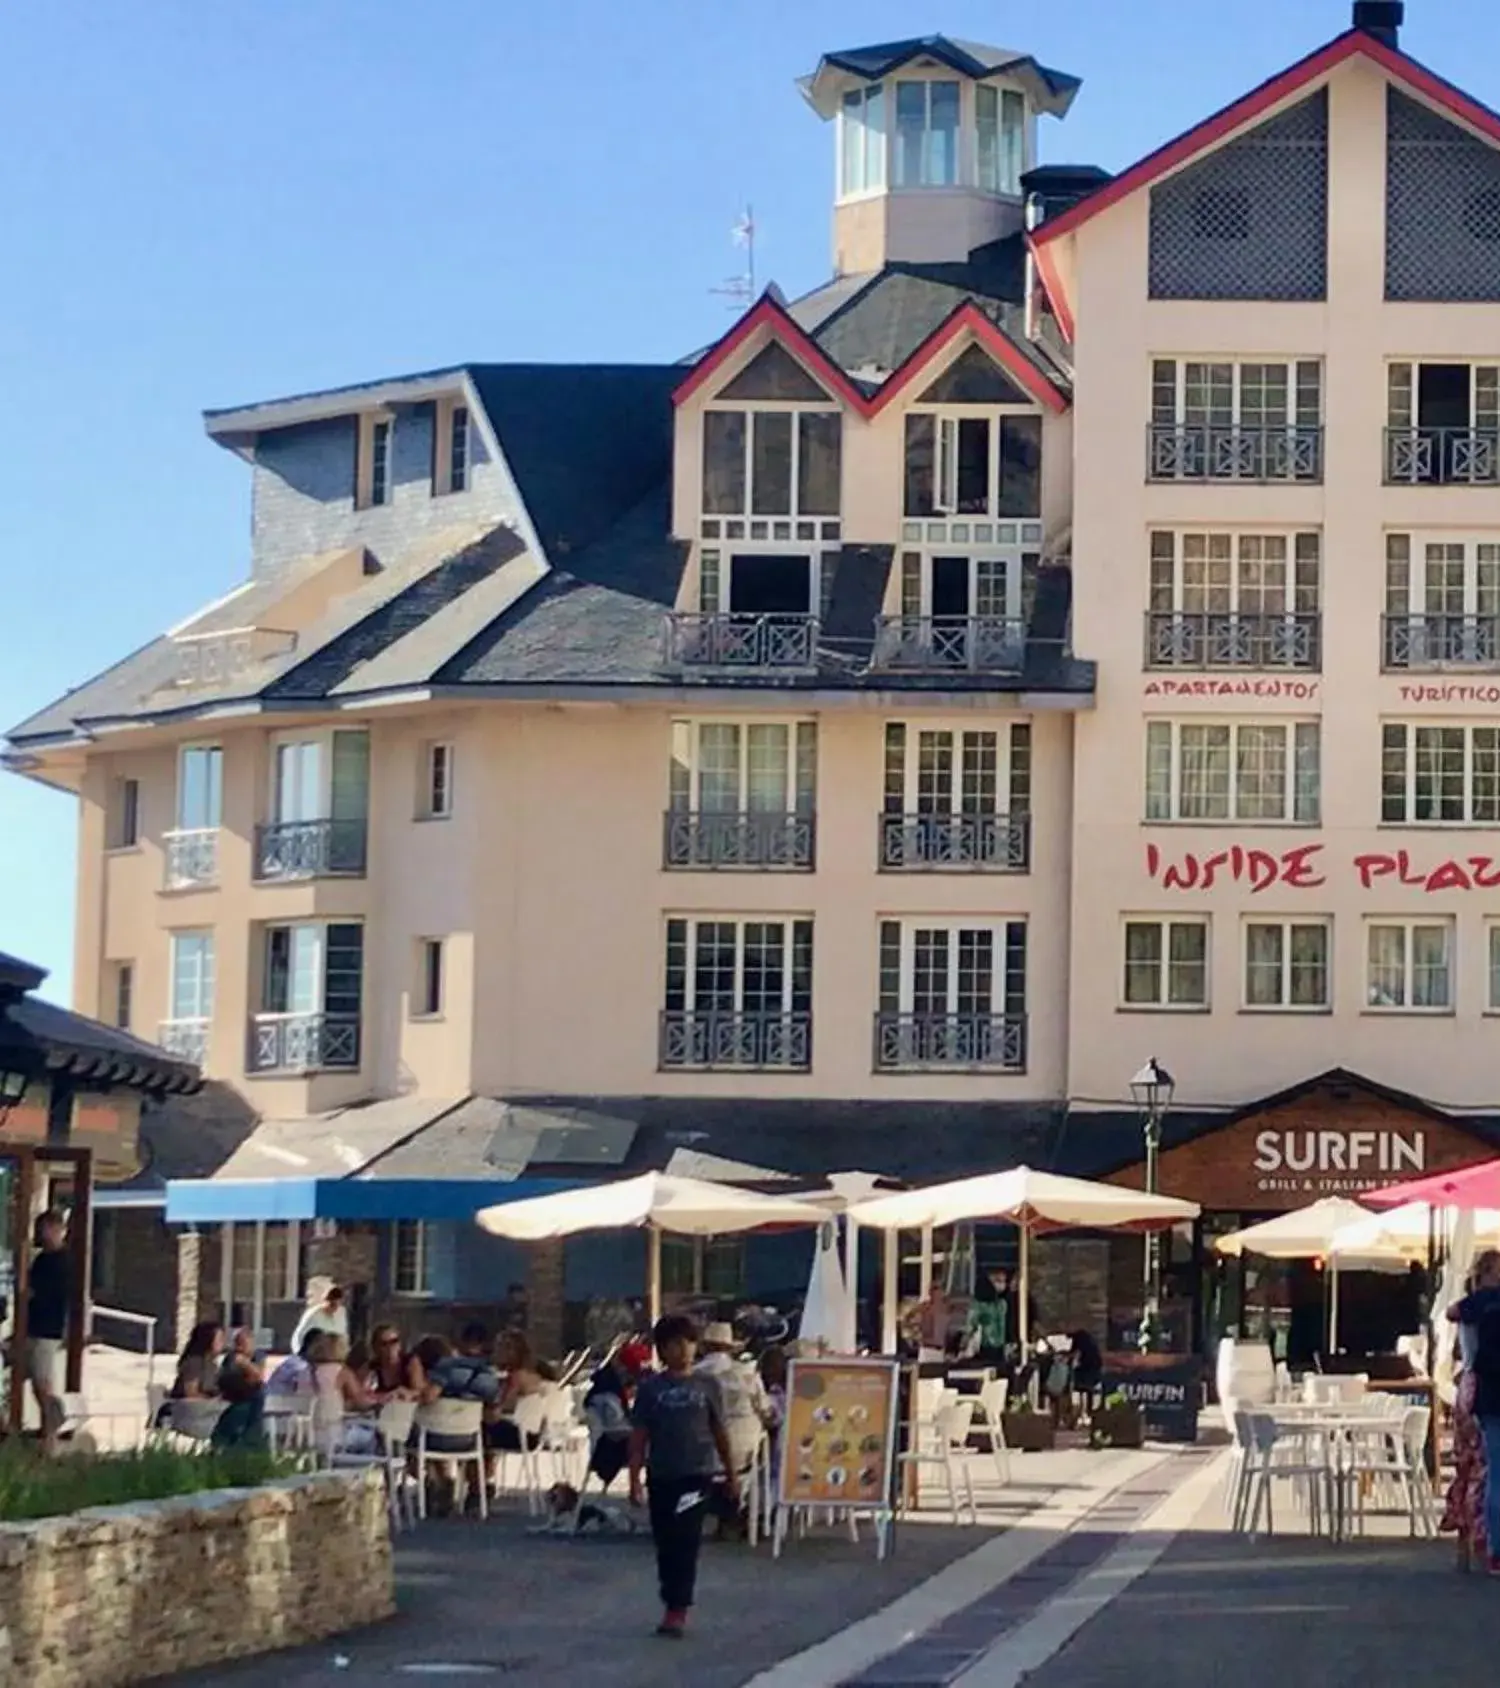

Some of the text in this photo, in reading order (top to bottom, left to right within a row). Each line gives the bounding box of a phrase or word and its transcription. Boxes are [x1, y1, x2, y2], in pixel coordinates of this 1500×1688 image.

[1144, 679, 1319, 699] APARTAMENTOS
[1147, 844, 1325, 893] INSIDE
[1254, 1131, 1425, 1171] SURFIN
[1257, 1178, 1298, 1191] GRILL
[1319, 1178, 1376, 1191] ITALIAN
[1117, 1383, 1185, 1402] SURFIN
